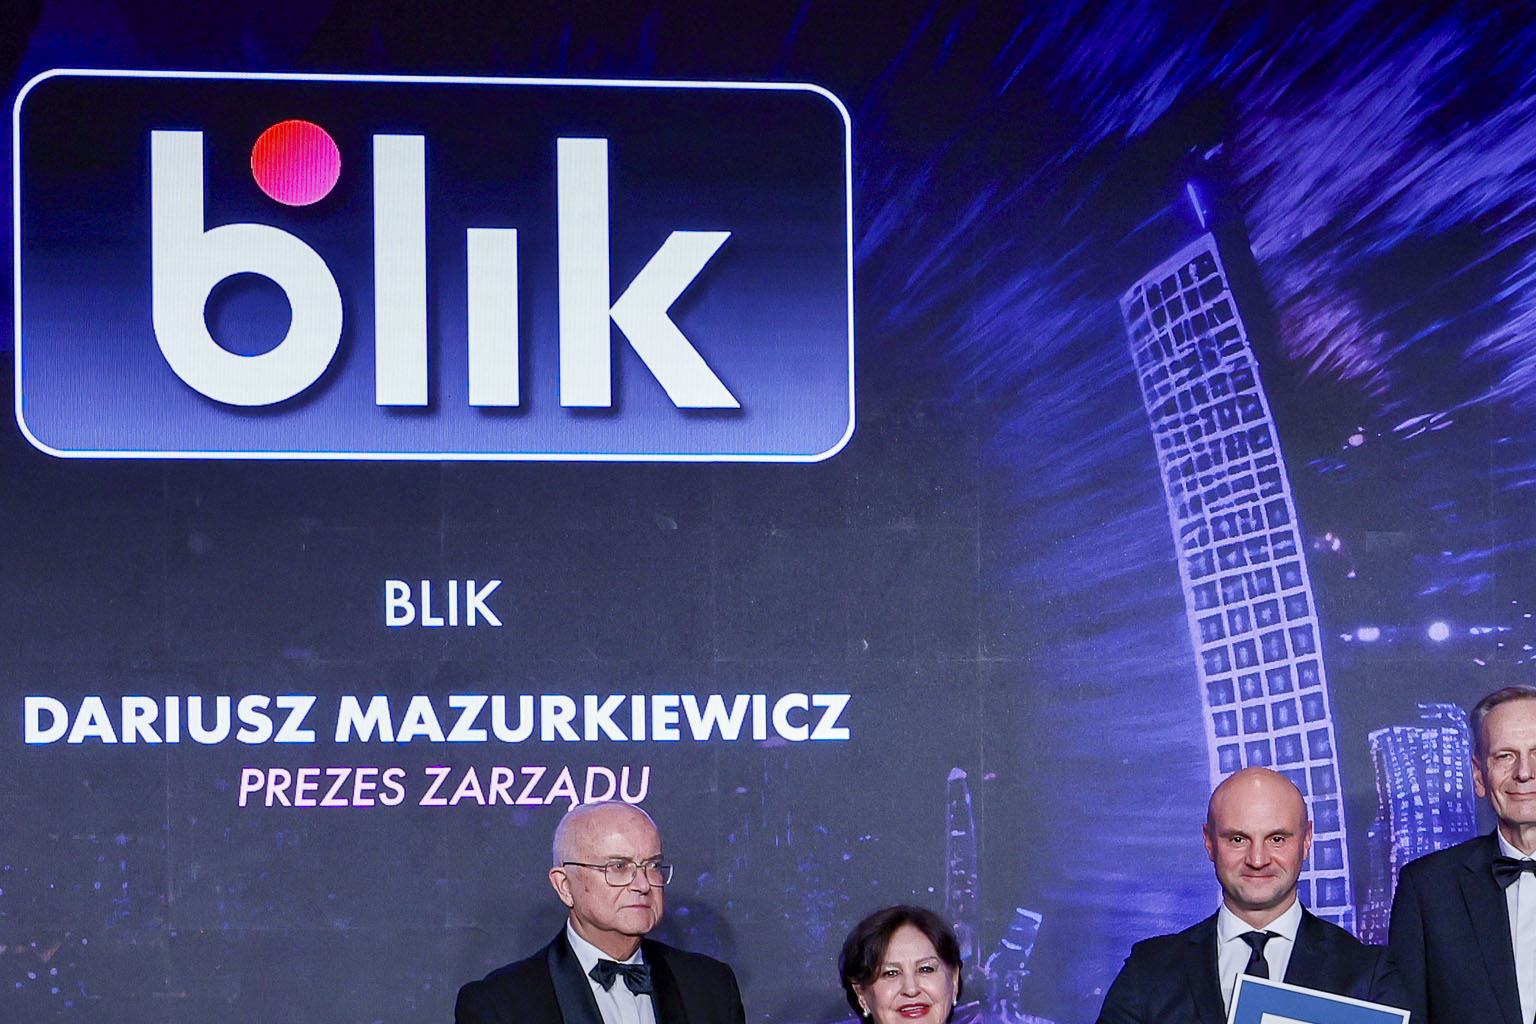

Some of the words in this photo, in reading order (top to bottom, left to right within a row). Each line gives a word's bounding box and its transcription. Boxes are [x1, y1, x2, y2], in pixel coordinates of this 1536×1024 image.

[152, 130, 740, 409] blik
[385, 580, 503, 627] BLIK
[24, 696, 316, 744] DARIUSZ
[334, 693, 852, 744] MAZURKIEWICZ
[238, 767, 406, 807] PREZES
[418, 766, 652, 812] ZARZĄDU
